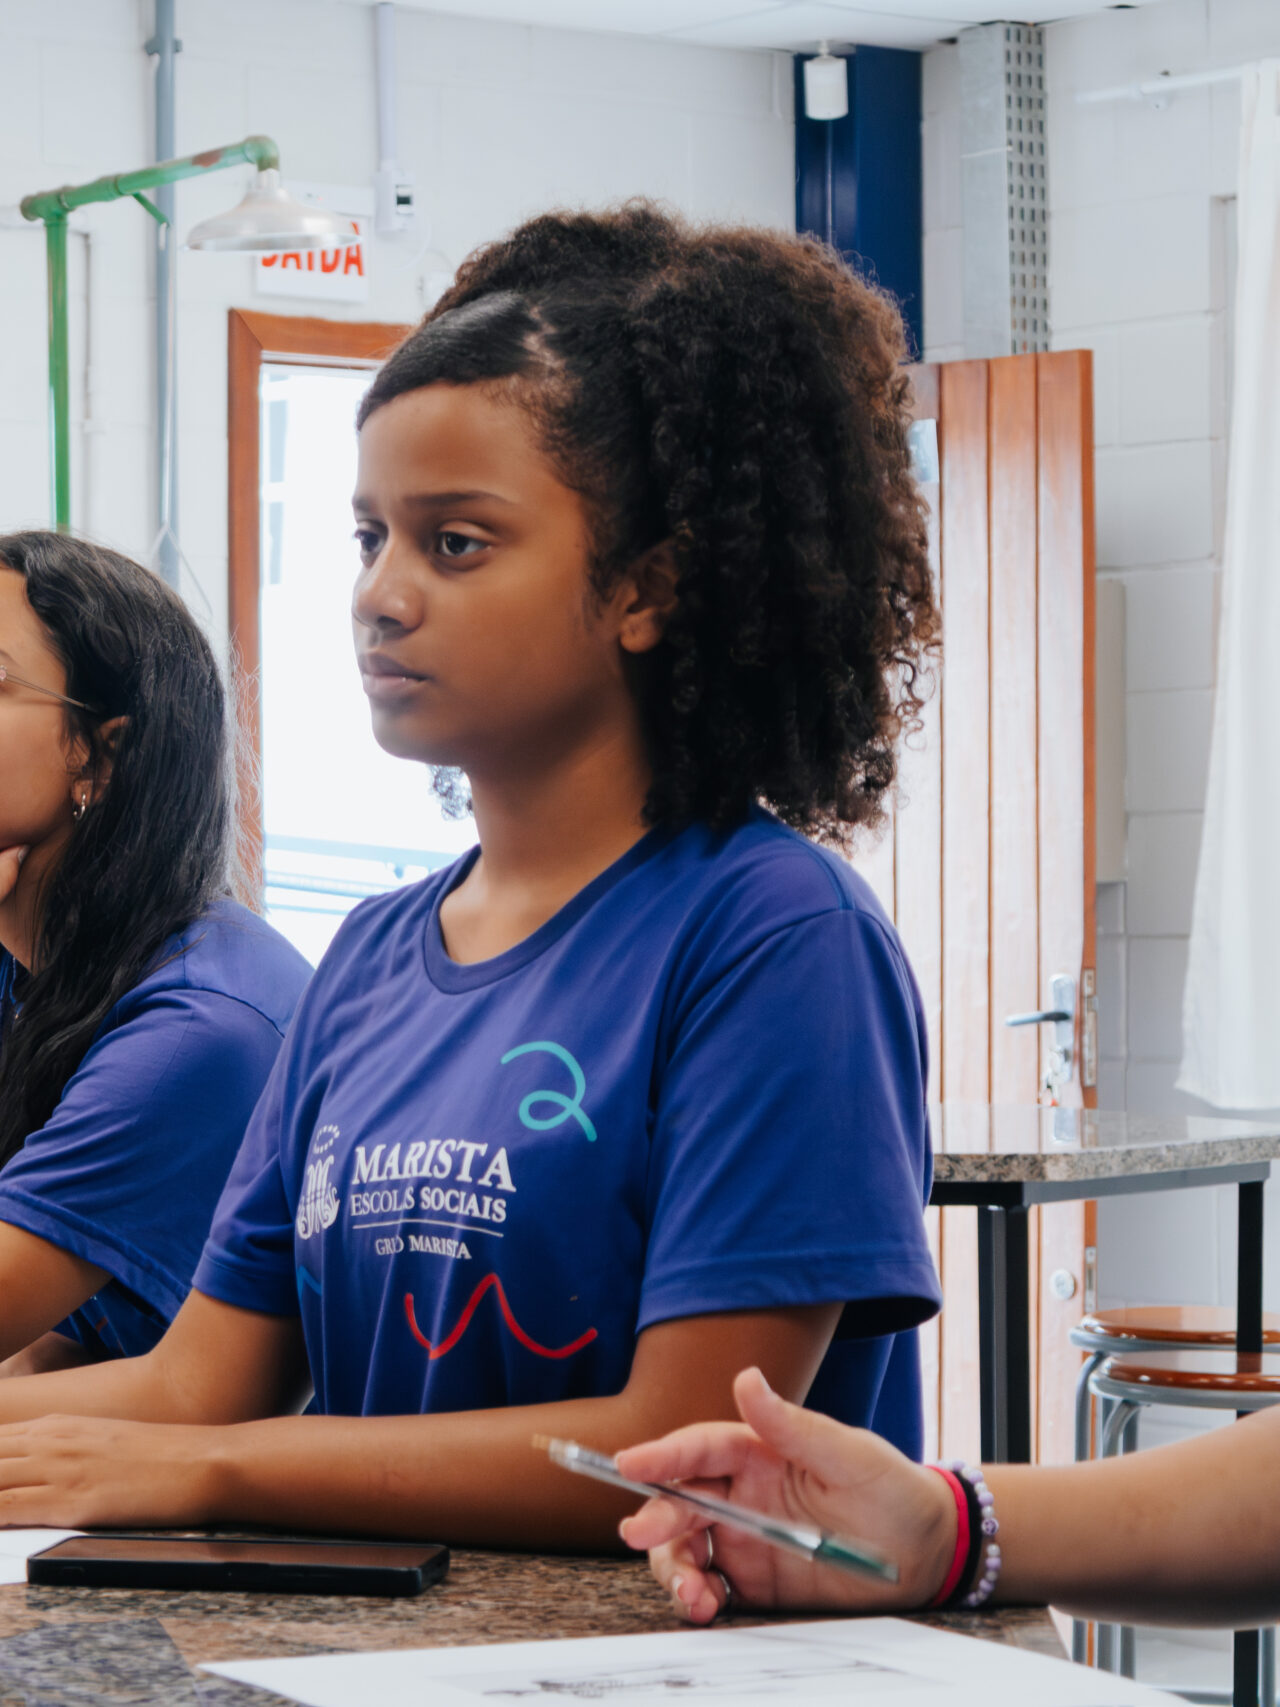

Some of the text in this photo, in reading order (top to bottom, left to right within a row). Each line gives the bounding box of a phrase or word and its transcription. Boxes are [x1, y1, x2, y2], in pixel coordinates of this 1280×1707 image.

[353, 1139, 516, 1192] MARISTA
[420, 1186, 506, 1222] SOCIAIS
[408, 1234, 472, 1260] MARISTA
